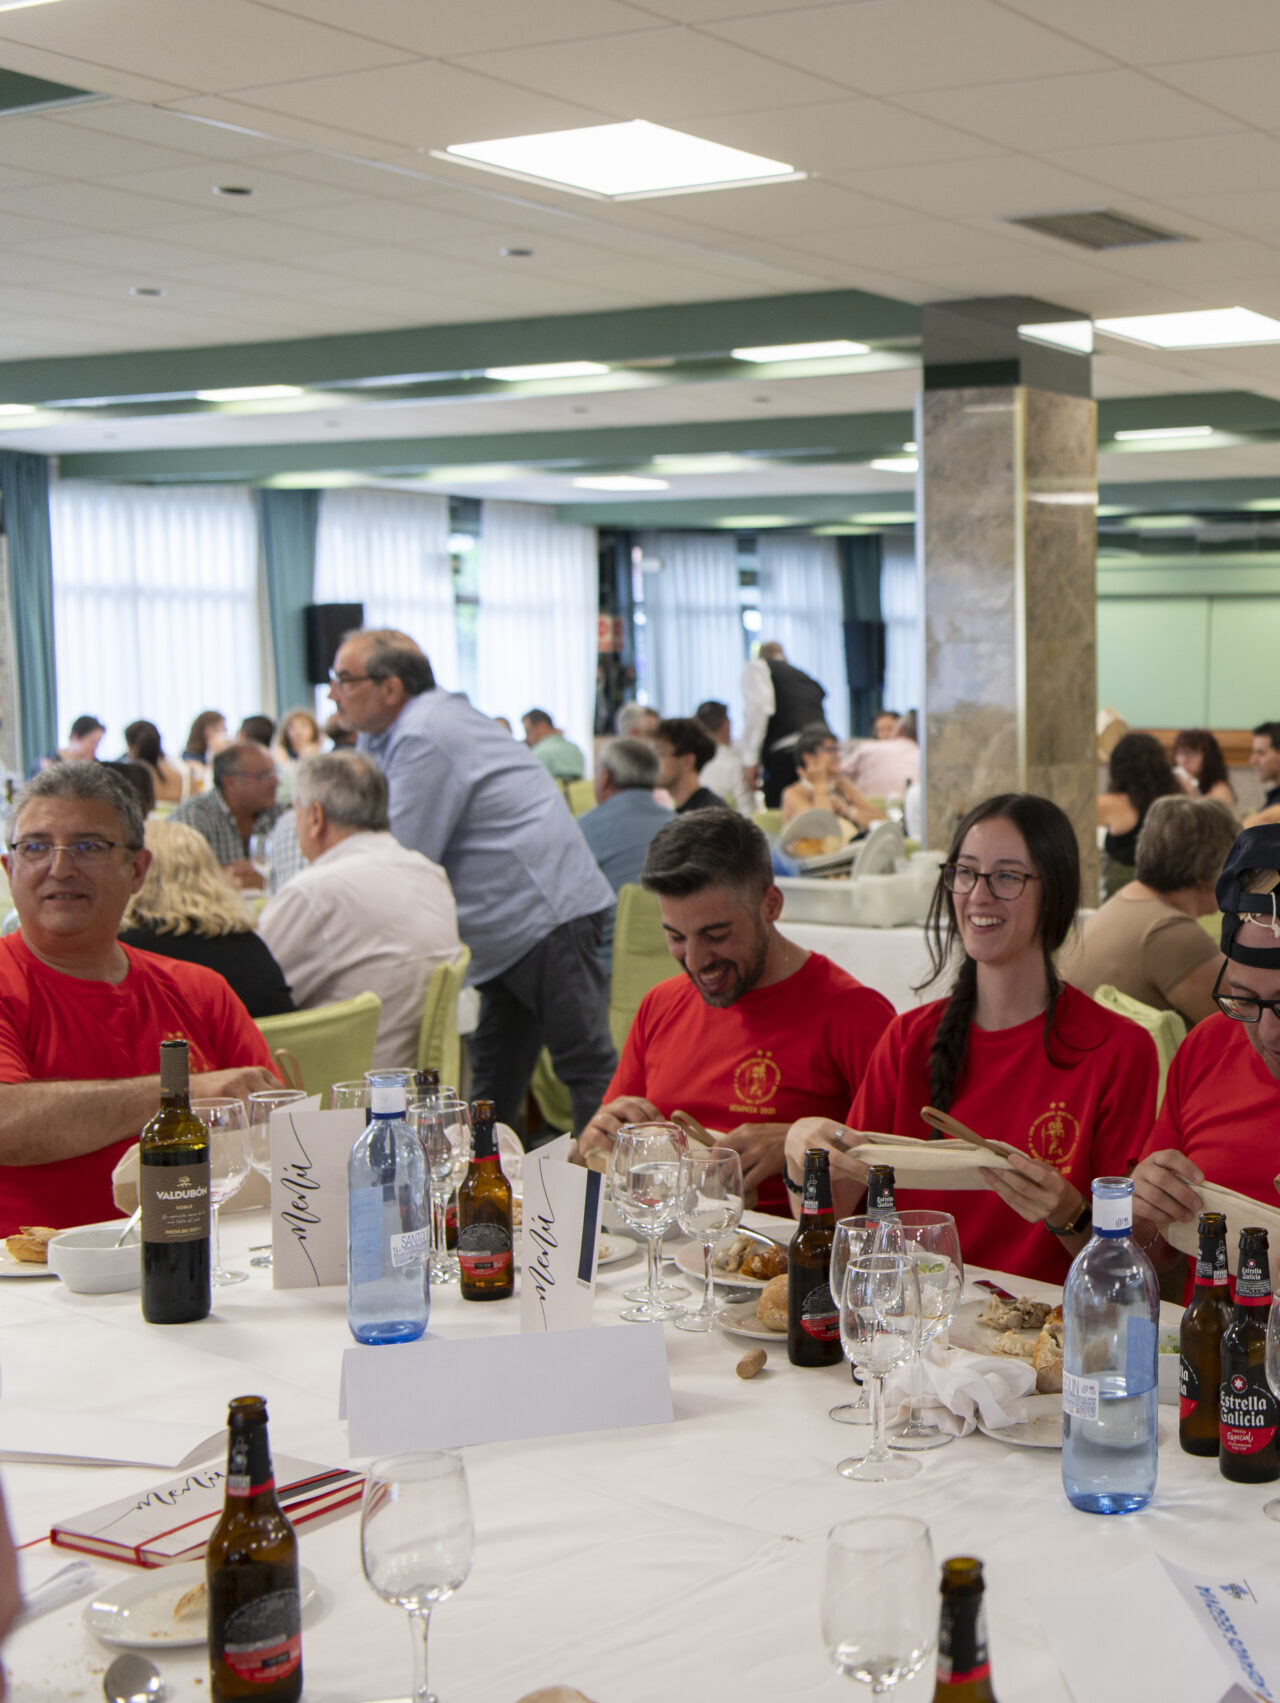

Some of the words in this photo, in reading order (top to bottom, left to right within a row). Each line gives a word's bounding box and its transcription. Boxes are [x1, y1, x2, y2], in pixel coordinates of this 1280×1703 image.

[156, 1186, 208, 1201] VALDUBÓN
[1220, 1390, 1267, 1411] Estrella
[1221, 1406, 1265, 1427] Galicia
